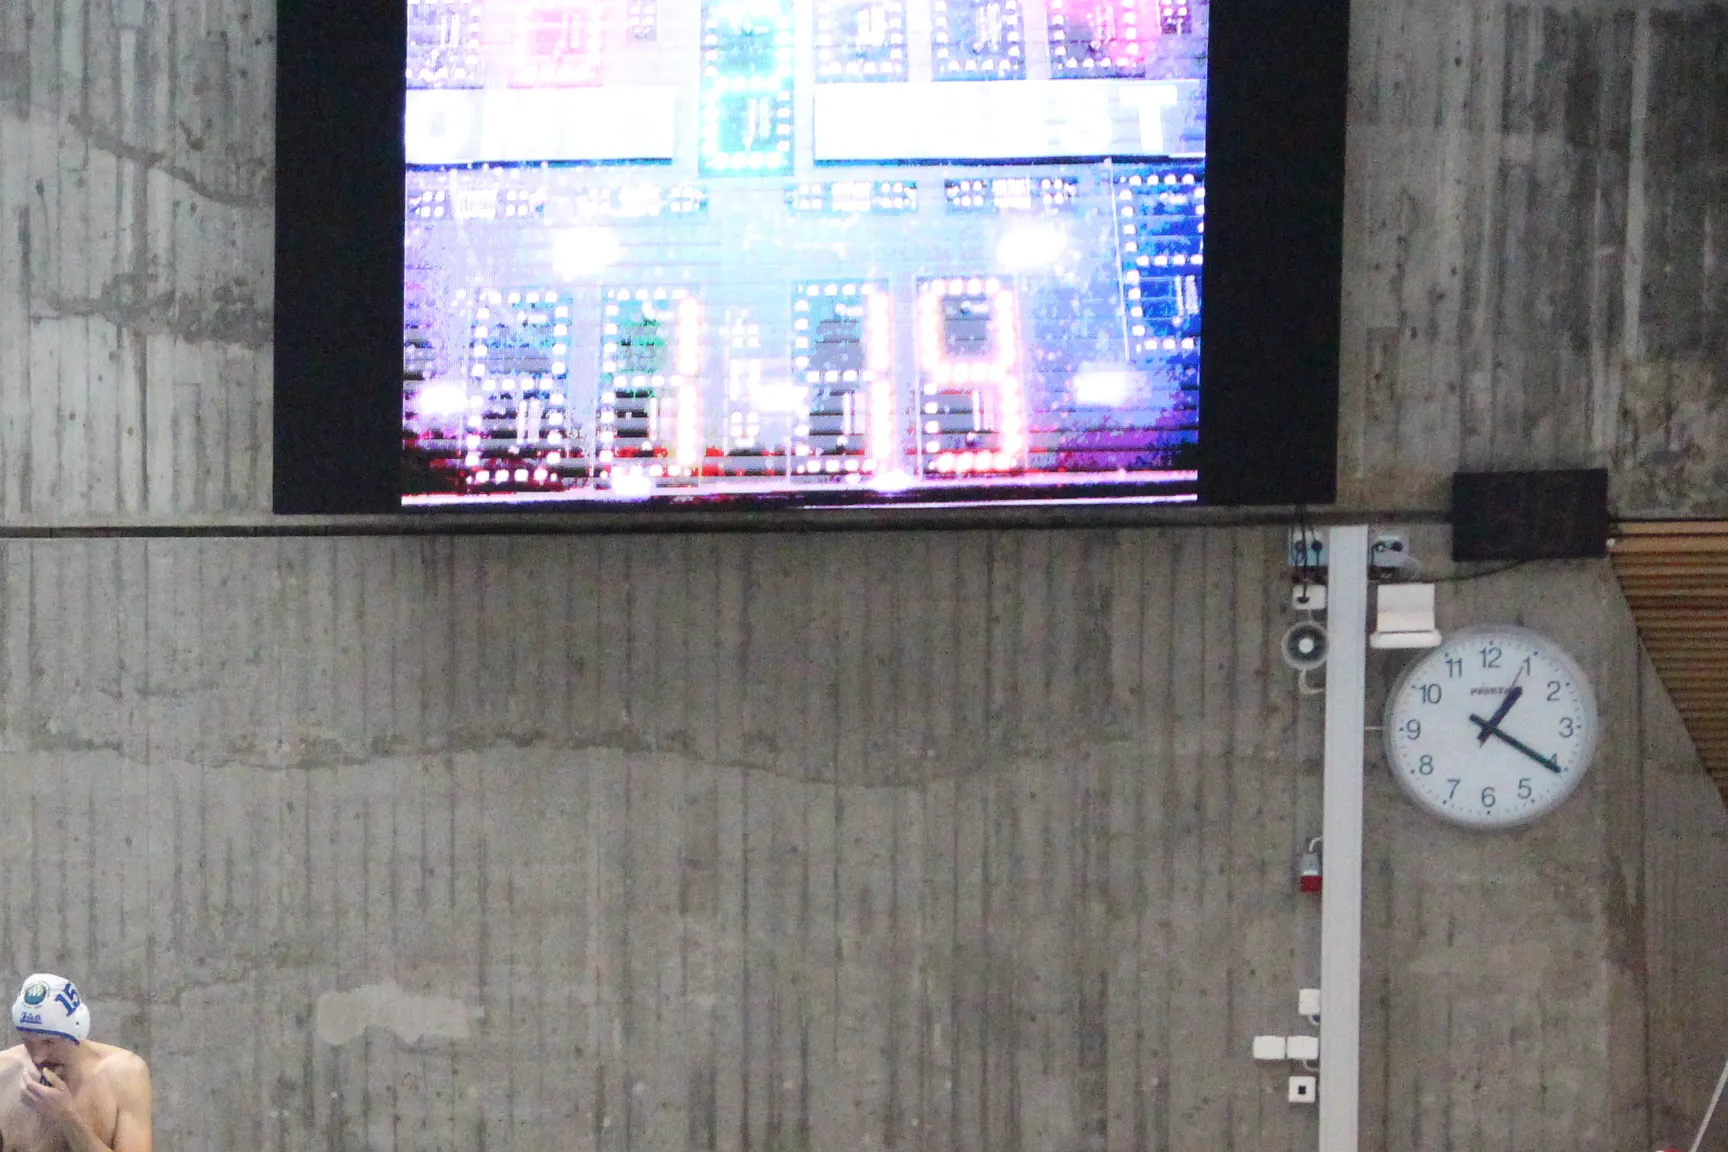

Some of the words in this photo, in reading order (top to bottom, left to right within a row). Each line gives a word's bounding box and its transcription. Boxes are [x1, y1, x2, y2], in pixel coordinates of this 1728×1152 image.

[1480, 647, 1502, 668] 12
[1523, 657, 1531, 676] 1
[1446, 658, 1463, 678] 11
[1421, 684, 1442, 704] 10
[1546, 681, 1560, 701] 2
[1406, 719, 1421, 740] 9
[1559, 717, 1573, 738] 3
[1419, 755, 1434, 775] 8
[1447, 779, 1461, 799] 7
[1481, 787, 1496, 808] 6
[1517, 778, 1532, 799] 5
[55, 983, 80, 1017] 15
